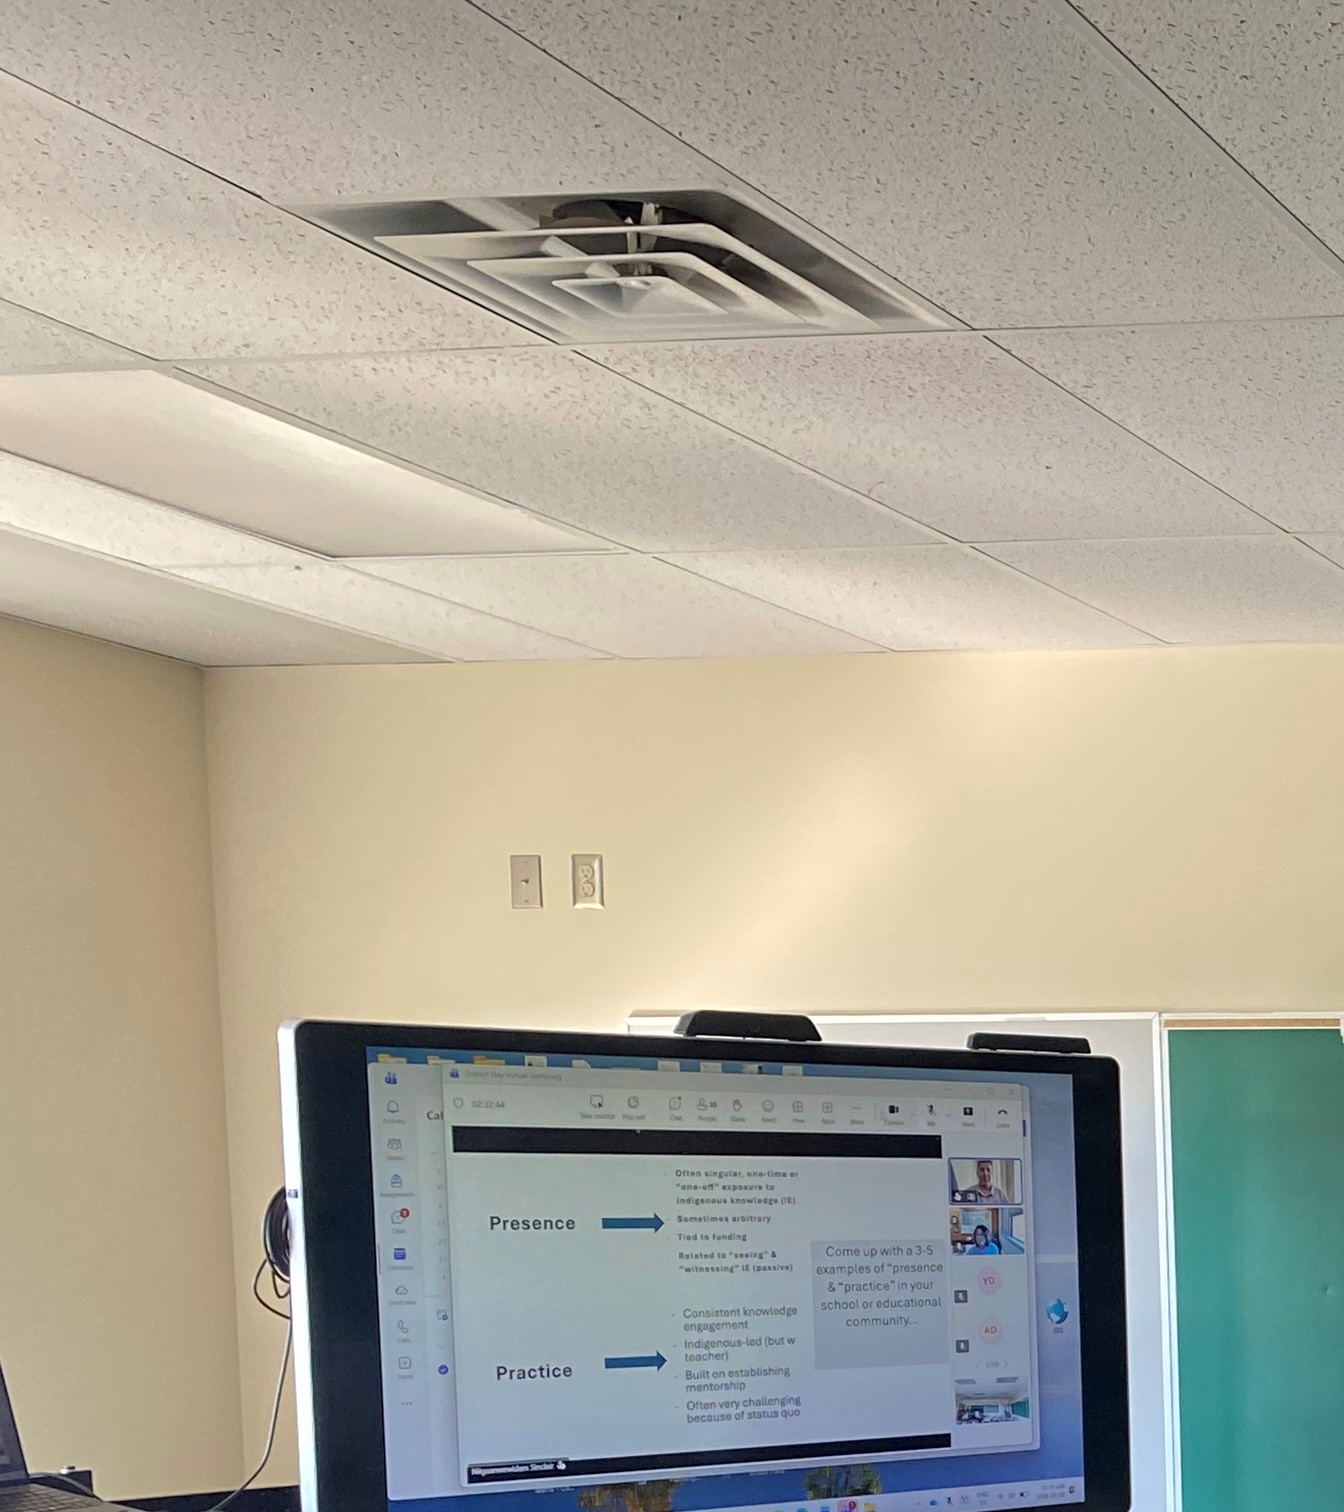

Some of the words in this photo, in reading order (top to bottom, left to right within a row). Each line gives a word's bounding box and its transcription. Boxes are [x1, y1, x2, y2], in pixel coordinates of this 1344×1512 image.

[675, 1169, 701, 1178] Often
[747, 1170, 787, 1178] one-time
[722, 1184, 763, 1193] exposure
[677, 1197, 728, 1206] Indigenous
[730, 1197, 778, 1206] knowledge
[490, 1216, 575, 1230] Presence
[677, 1215, 729, 1223] Sometimes
[732, 1215, 771, 1224] arbitrary
[677, 1233, 698, 1241] Tied
[700, 1233, 710, 1241] to
[712, 1233, 747, 1242] funding
[678, 1252, 714, 1260] Related
[825, 1246, 860, 1257] Come
[863, 1247, 878, 1258] up
[880, 1245, 904, 1256] with
[906, 1247, 913, 1256] a
[915, 1245, 934, 1255] 3-5
[741, 1264, 750, 1272] IE
[752, 1264, 793, 1273] (passive)
[816, 1263, 871, 1276] examples
[873, 1263, 885, 1274] of
[982, 1276, 995, 1285] YD
[827, 1281, 836, 1293] &
[897, 1281, 908, 1291] in
[910, 1281, 934, 1293] your
[820, 1299, 859, 1311] school
[862, 1300, 873, 1309] or
[876, 1296, 942, 1309] educational
[683, 1308, 740, 1319] Consistent
[743, 1306, 798, 1317] knowledge
[683, 1321, 749, 1333] engagement
[984, 1326, 997, 1334] AD
[684, 1337, 762, 1350] Indigenous-led
[765, 1336, 785, 1348] (but
[787, 1337, 796, 1345] w
[685, 1351, 729, 1362] teacher)
[496, 1364, 573, 1381] Practice
[685, 1369, 710, 1381] Built
[712, 1370, 725, 1379] on
[727, 1366, 790, 1379] establishing
[686, 1381, 746, 1393] mentorship
[686, 1400, 716, 1411] Often
[718, 1400, 740, 1411] very
[742, 1395, 801, 1408] challenging
[687, 1412, 732, 1424] because
[734, 1410, 745, 1421] of
[747, 1409, 779, 1419] status
[780, 1408, 800, 1419] quo
